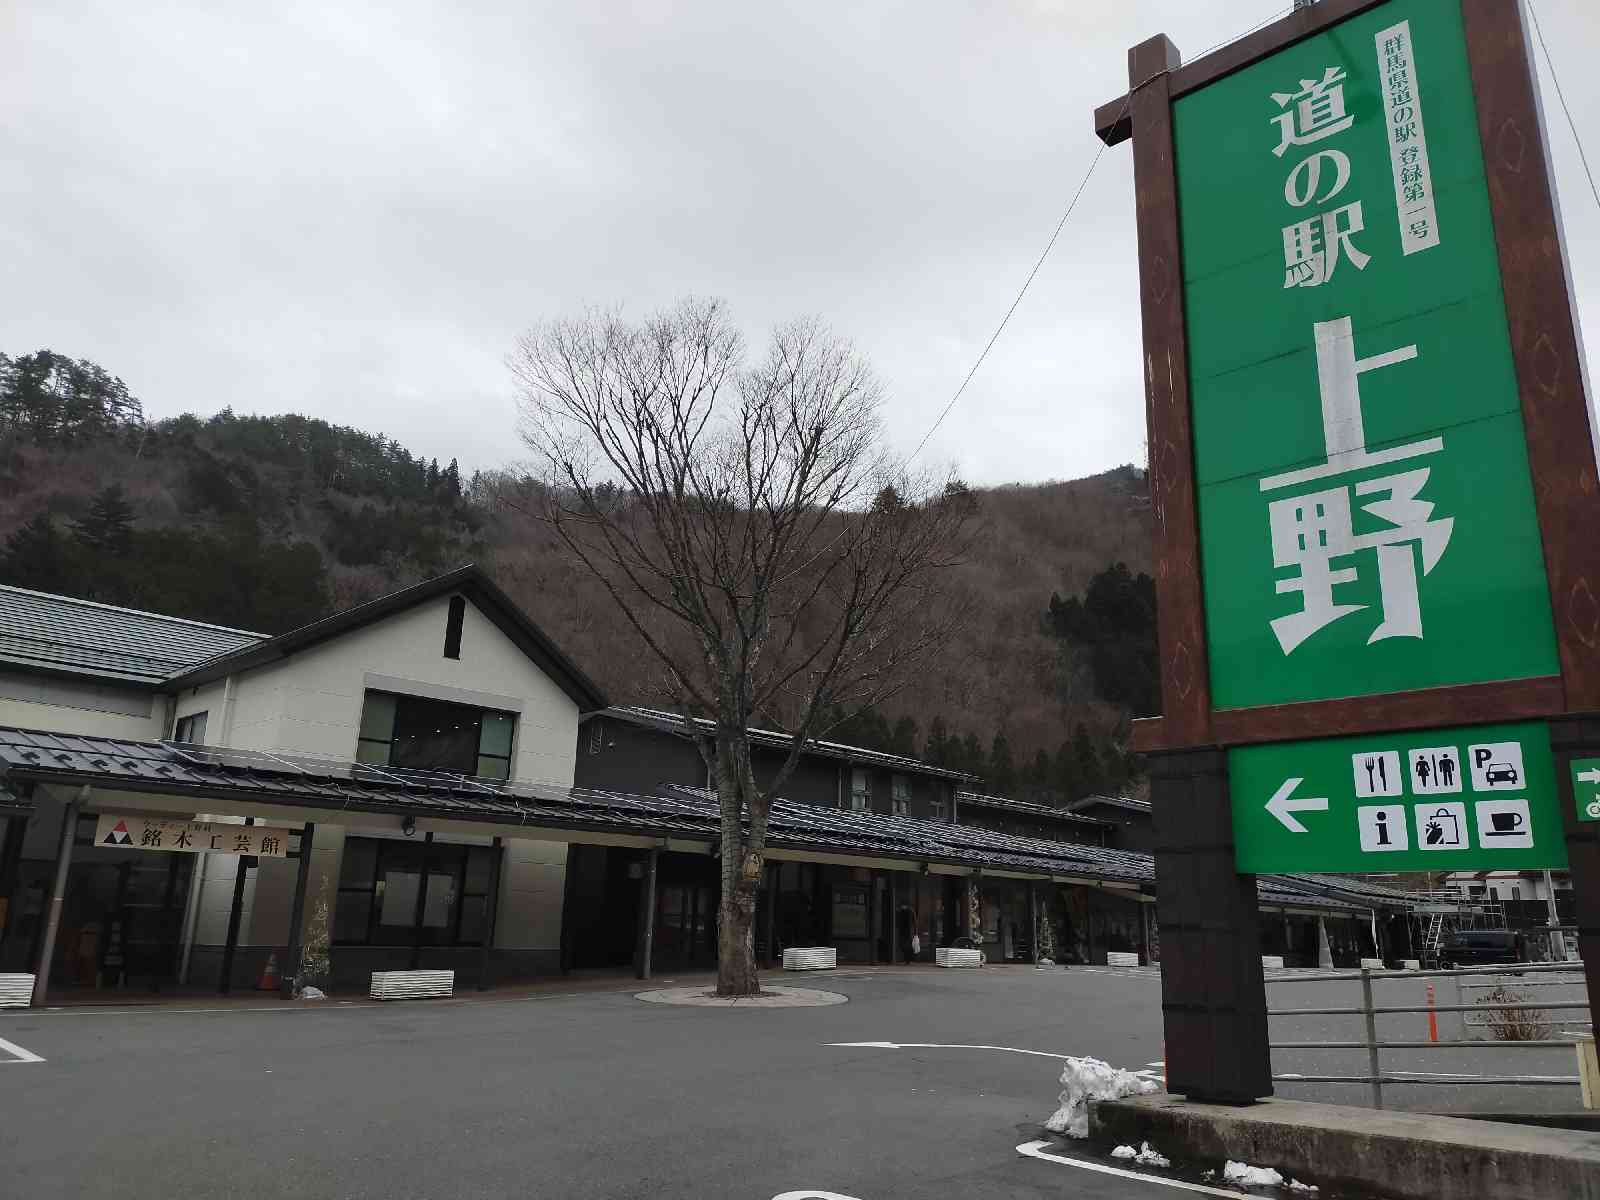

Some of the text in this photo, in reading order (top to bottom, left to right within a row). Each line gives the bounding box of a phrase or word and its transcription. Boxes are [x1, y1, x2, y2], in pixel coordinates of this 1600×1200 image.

[1270, 66, 1372, 288] 道の駅
[1259, 315, 1454, 656] 上野
[1475, 749, 1492, 768] P
